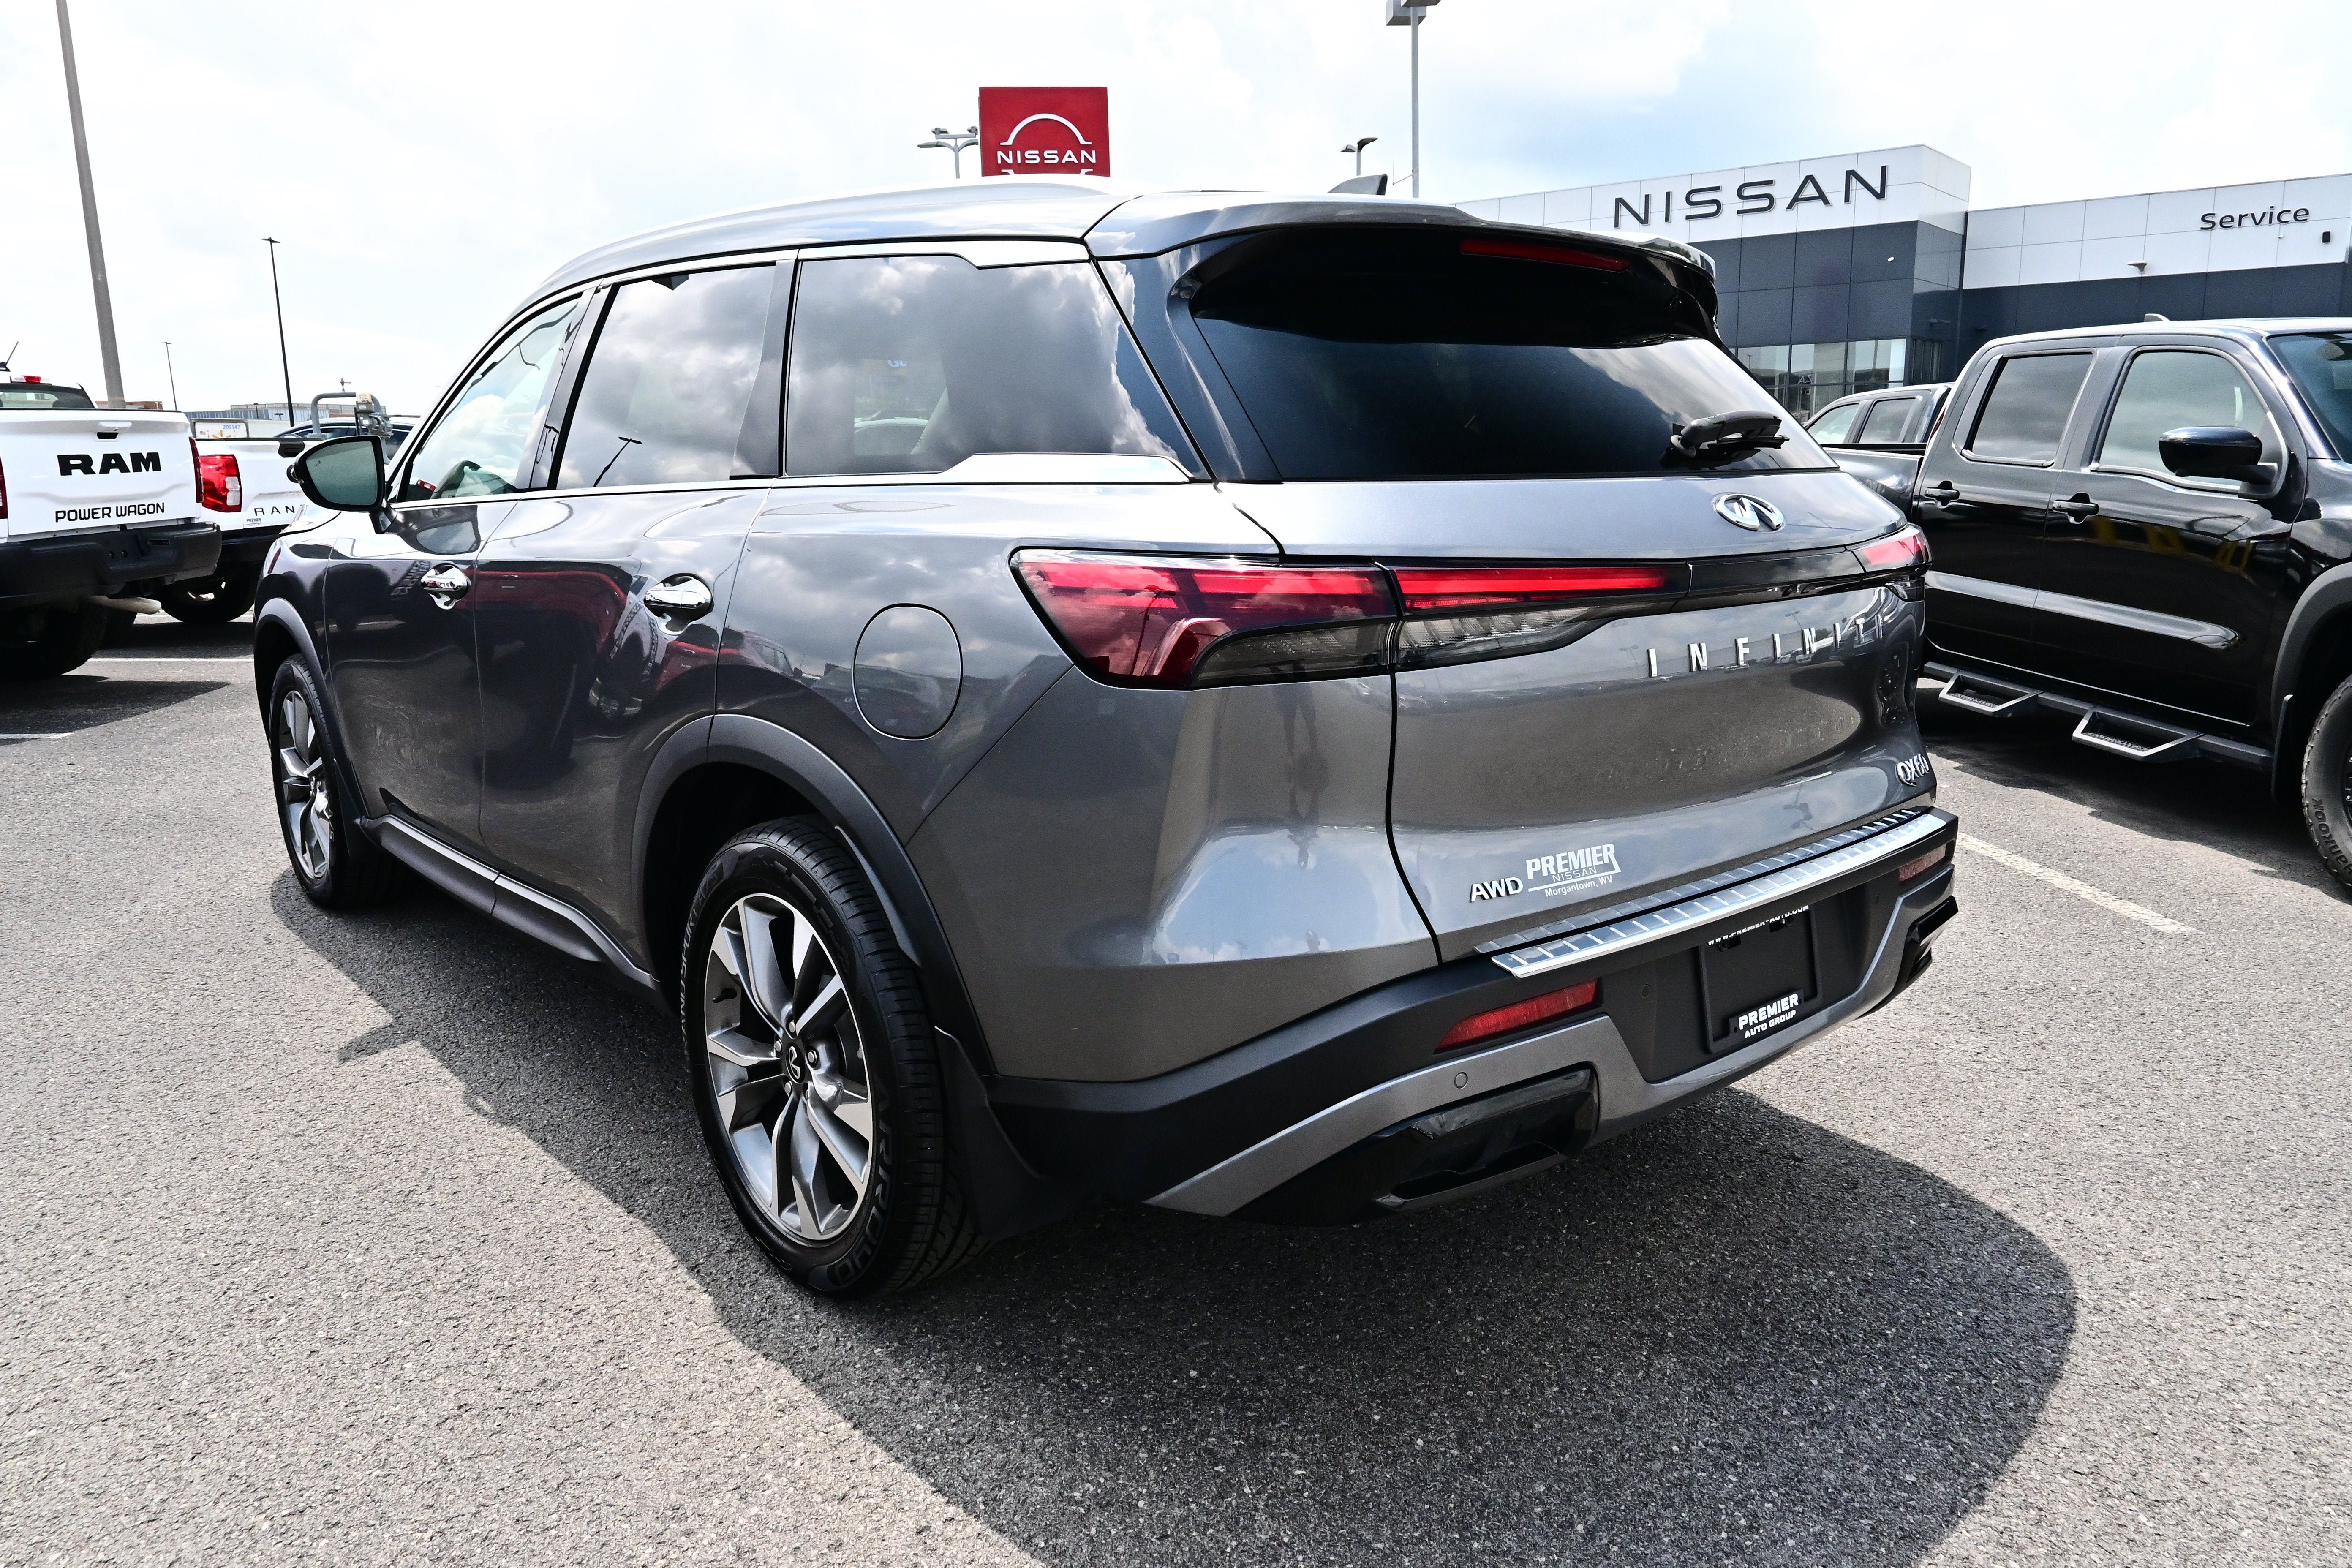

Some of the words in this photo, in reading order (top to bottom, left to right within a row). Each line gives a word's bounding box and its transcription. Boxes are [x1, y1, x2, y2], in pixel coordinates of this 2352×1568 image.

[997, 150, 1096, 164] NISSAN
[1614, 165, 1889, 229] NISSAN
[2200, 205, 2309, 230] Service
[57, 452, 161, 476] RAM
[55, 507, 111, 522] POWER
[116, 502, 164, 517] WAGON
[254, 505, 302, 516] RAN
[1647, 614, 1883, 678] INFINITI
[1896, 753, 1929, 786] QX60
[1526, 843, 1620, 879] PREMIER
[1544, 879, 1598, 897] Morgantown,
[1598, 875, 1612, 887] WV
[1552, 866, 1597, 882] NISSAN
[1469, 877, 1523, 902] AWD
[1738, 993, 1799, 1030] PREMIER
[1744, 1023, 1767, 1038] AUTO
[1769, 1010, 1796, 1027] GROUP
